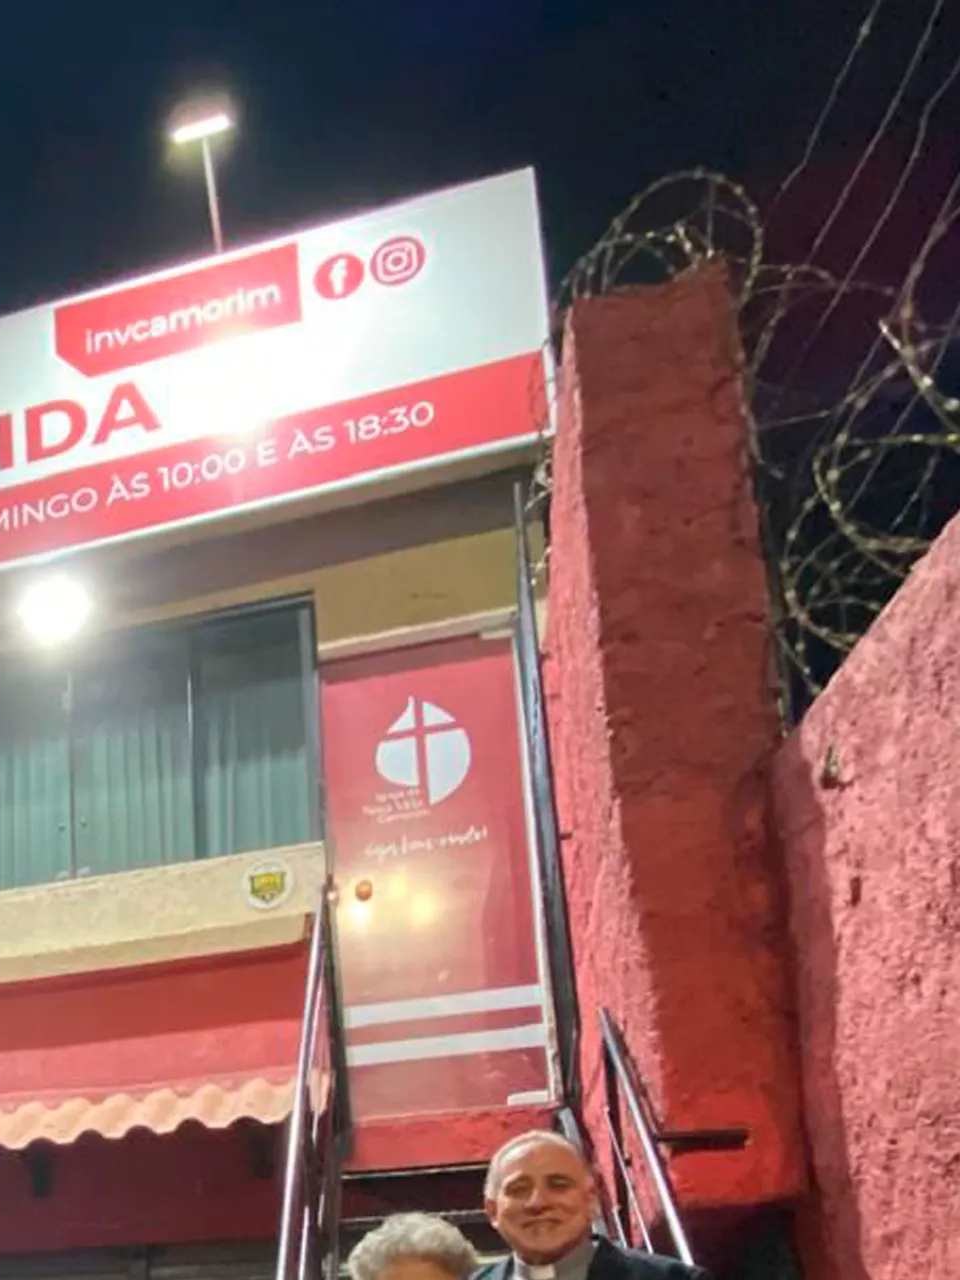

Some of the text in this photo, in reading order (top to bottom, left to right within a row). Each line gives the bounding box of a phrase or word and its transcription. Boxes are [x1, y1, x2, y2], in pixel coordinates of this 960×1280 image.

[86, 282, 281, 354] invcamorim
[106, 473, 151, 507] ÀS
[157, 449, 246, 492] 10:00
[255, 439, 279, 468] E
[287, 427, 336, 460] ÀS
[344, 400, 436, 445] 18:30
